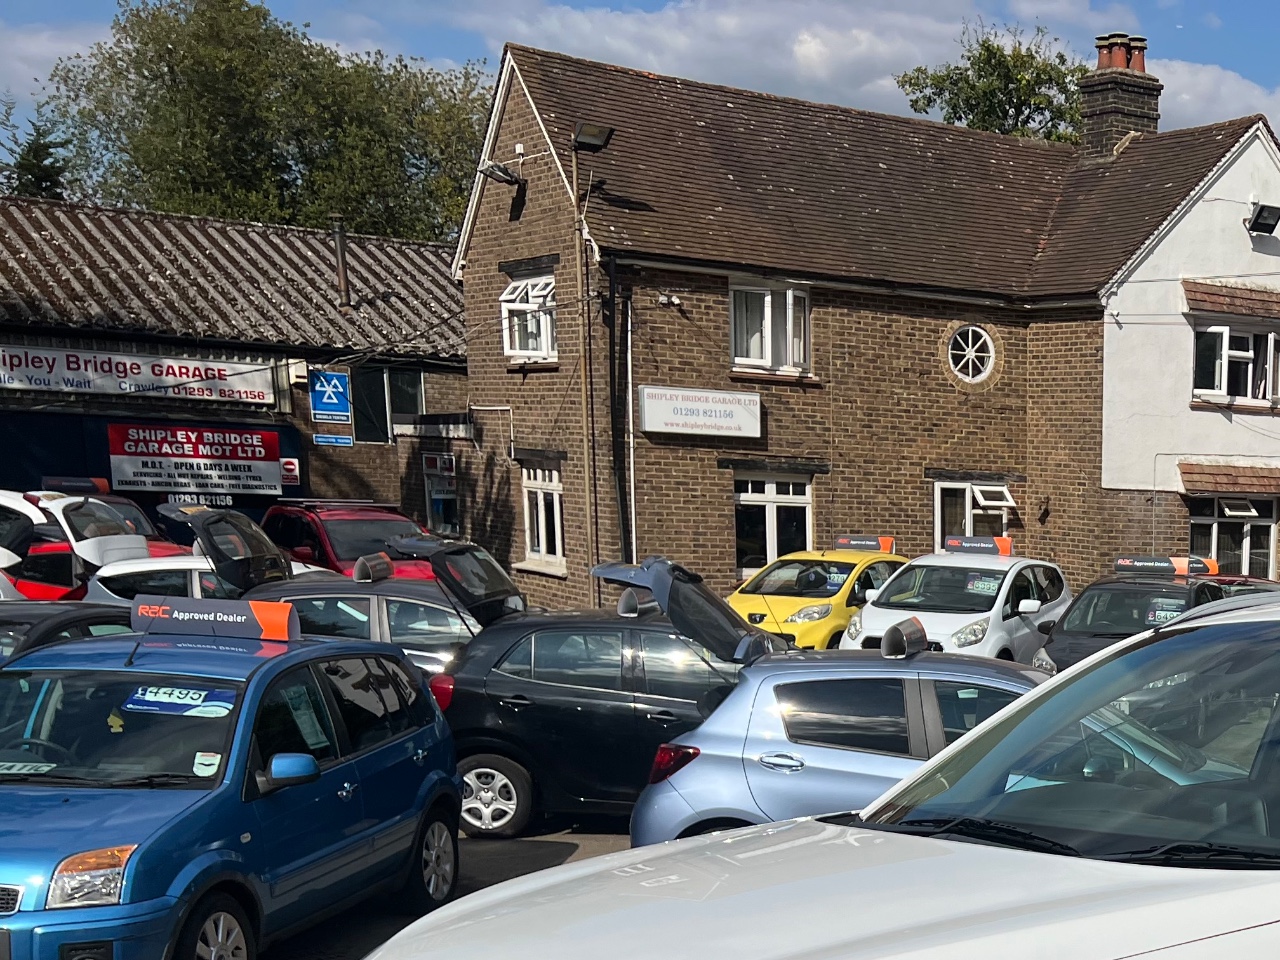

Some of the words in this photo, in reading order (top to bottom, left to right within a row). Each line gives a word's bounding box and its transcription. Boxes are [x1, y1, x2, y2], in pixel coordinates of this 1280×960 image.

[65, 353, 142, 379] Bridge
[151, 363, 228, 381] GARAGE
[26, 375, 51, 386] You
[62, 377, 91, 389] Wait
[172, 386, 213, 397] 01293
[219, 389, 265, 400] 821156
[646, 392, 681, 402] SHIPLEY
[682, 394, 710, 404] BRIDGE
[712, 396, 743, 406] GARAGE
[743, 399, 758, 407] LTD
[673, 407, 700, 417] 01293
[702, 408, 734, 419] 821156
[664, 421, 742, 432] www.shipleybridge.co.uk
[128, 428, 198, 443] SHIPLEY
[203, 432, 262, 446] BRIDGE
[124, 441, 194, 455] GARAGE
[198, 444, 232, 457] MOT
[237, 446, 266, 458] LTD
[174, 461, 194, 471] OPEN
[203, 463, 222, 471] DAYS
[224, 464, 230, 472] A
[230, 464, 252, 473] WEEK
[168, 494, 198, 504] 01293
[199, 495, 233, 506] 821156
[172, 610, 214, 621] Approved
[216, 612, 247, 623] Dealer
